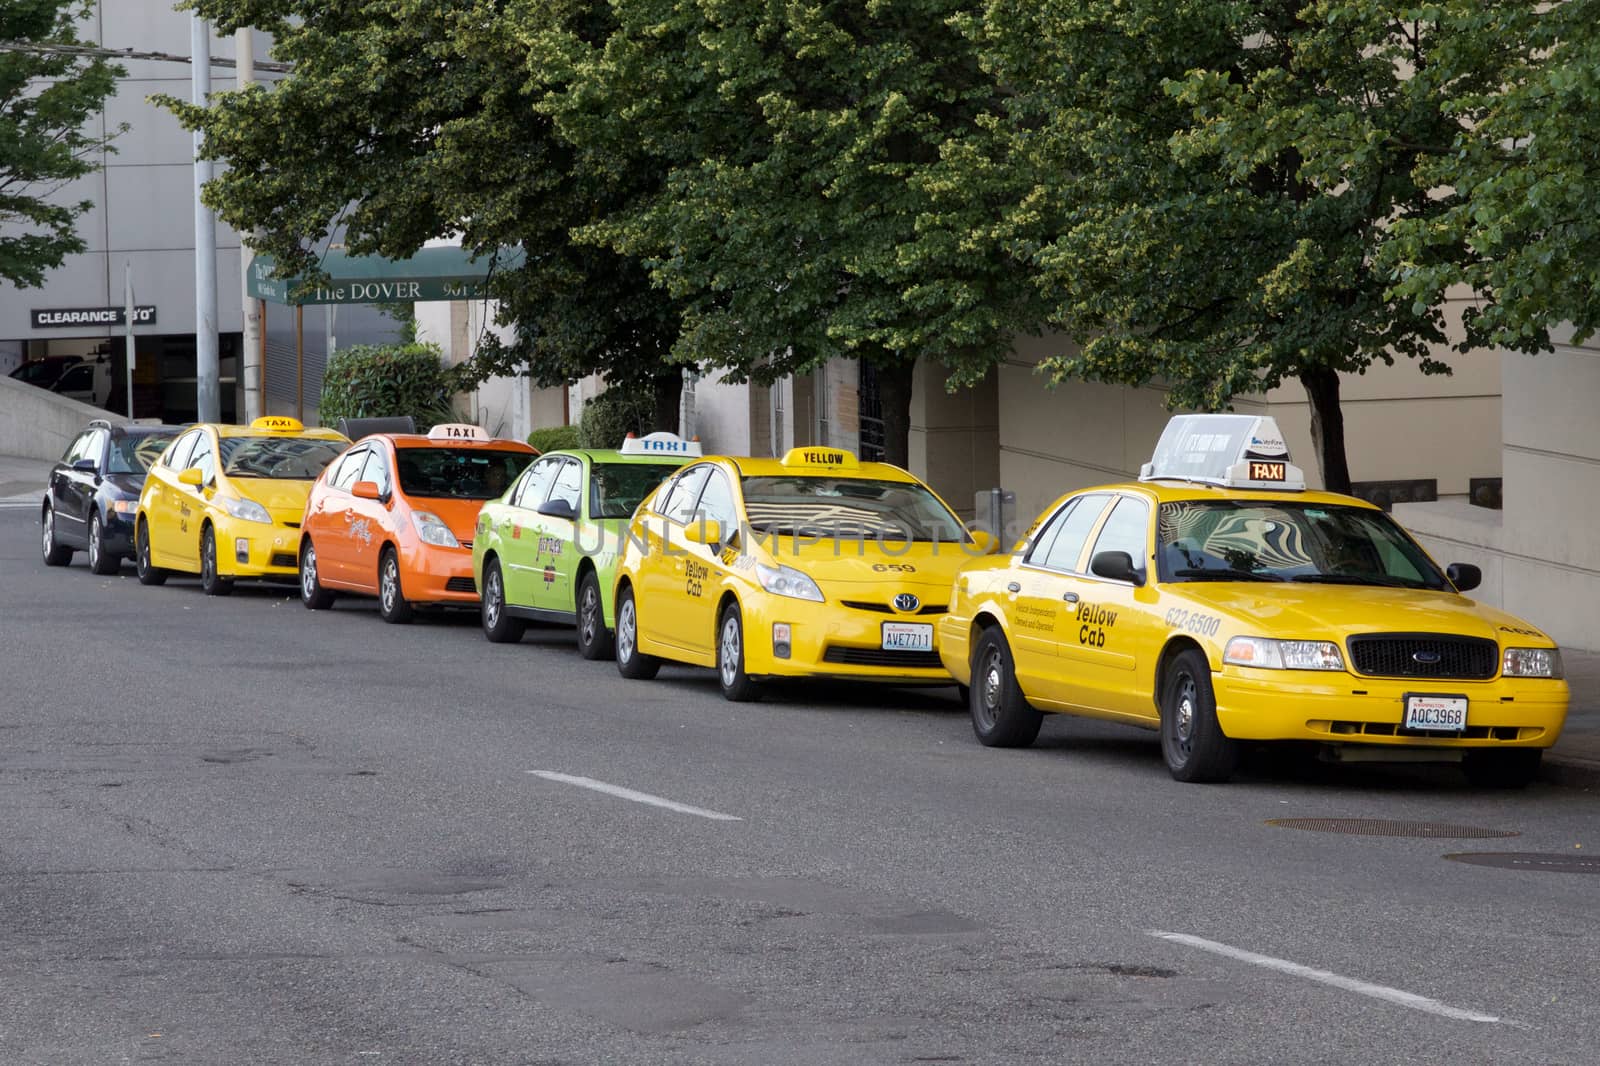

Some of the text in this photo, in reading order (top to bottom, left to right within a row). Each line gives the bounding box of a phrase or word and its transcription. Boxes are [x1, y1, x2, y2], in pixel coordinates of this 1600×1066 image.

[351, 281, 421, 300] DOVER
[38, 311, 117, 324] CLEARANCE
[446, 427, 475, 438] TAXI
[641, 440, 688, 452] TAXI
[803, 452, 844, 465] YELLOW
[1252, 463, 1284, 480] TAXI
[685, 559, 709, 581] Yellow
[872, 563, 917, 573] 659
[687, 579, 702, 597] Cab
[1076, 601, 1118, 628] Yellow
[1164, 607, 1221, 638] 622-6500
[886, 632, 929, 648] AVE7711
[1079, 626, 1105, 648] Cab
[1410, 708, 1462, 725] AQC3968
